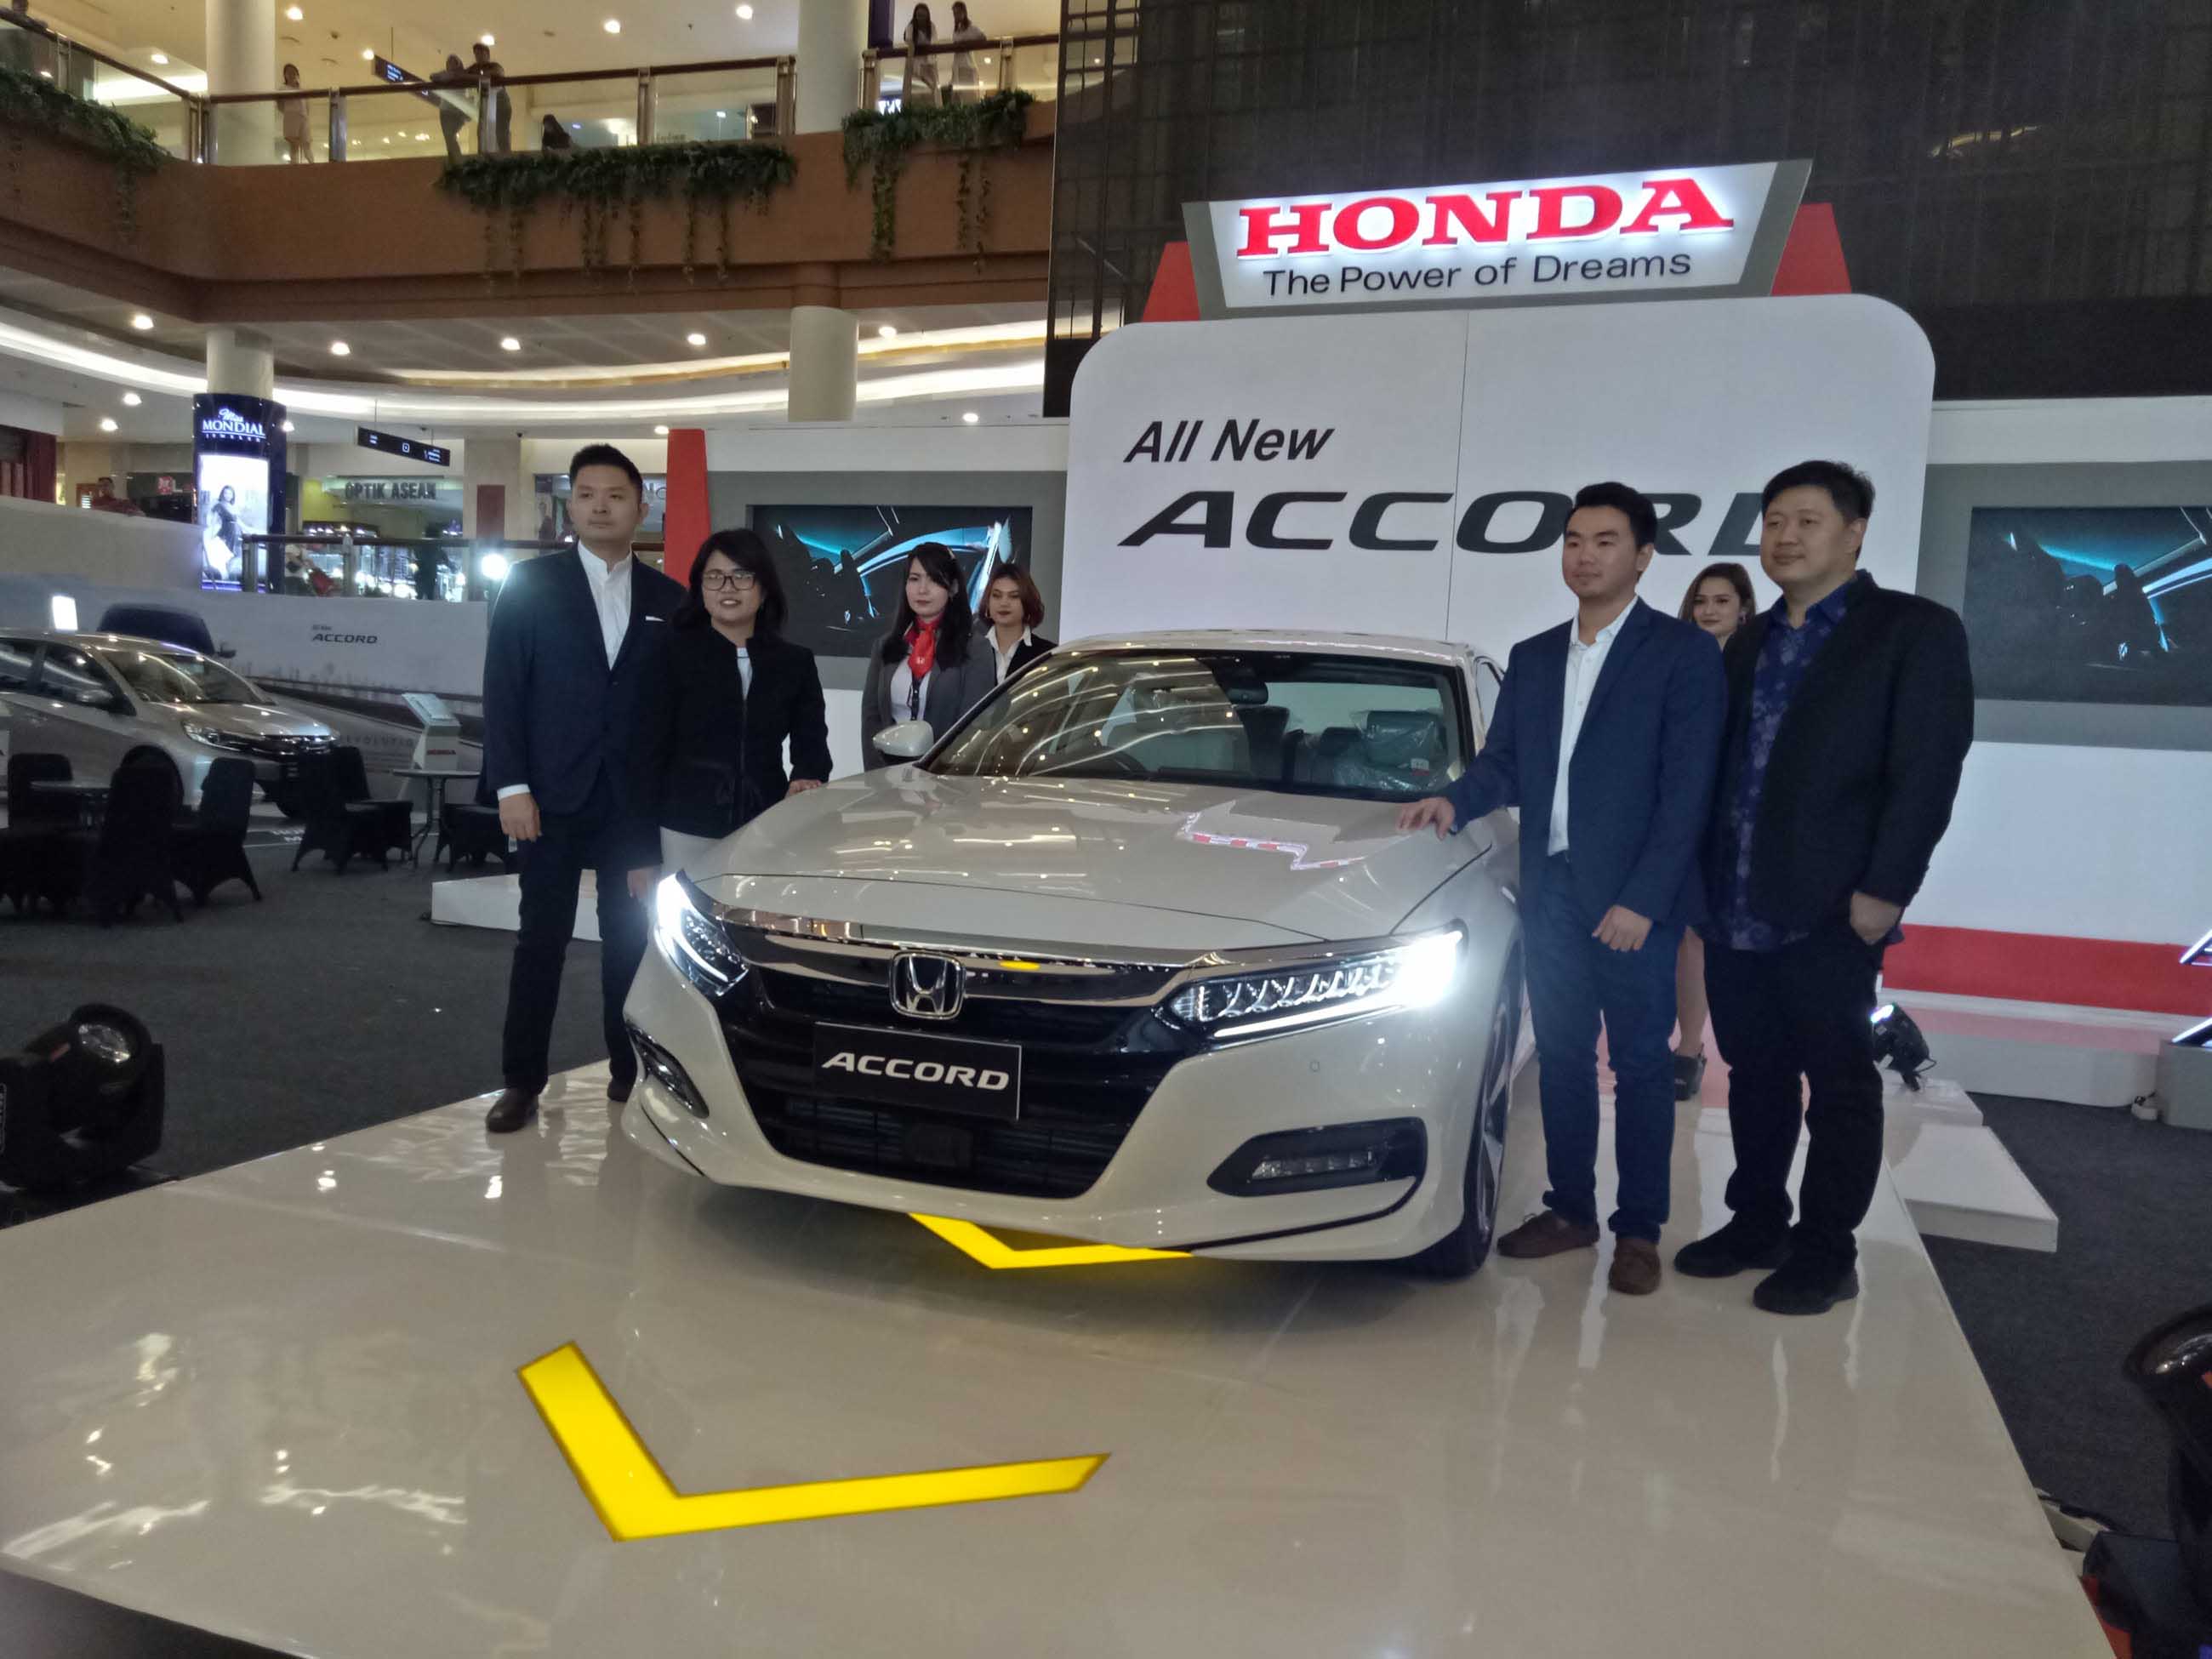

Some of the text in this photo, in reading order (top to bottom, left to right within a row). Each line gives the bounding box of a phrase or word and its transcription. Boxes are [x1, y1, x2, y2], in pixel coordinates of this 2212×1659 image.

[1237, 177, 1735, 257] HONDA
[1263, 253, 1693, 296] The Power of Dreams
[202, 419, 265, 436] MONDIAL
[1122, 418, 1336, 464] All New
[345, 482, 385, 499] OPTIK
[311, 633, 378, 644] ACCORD
[821, 1052, 1010, 1091] ACCORD
